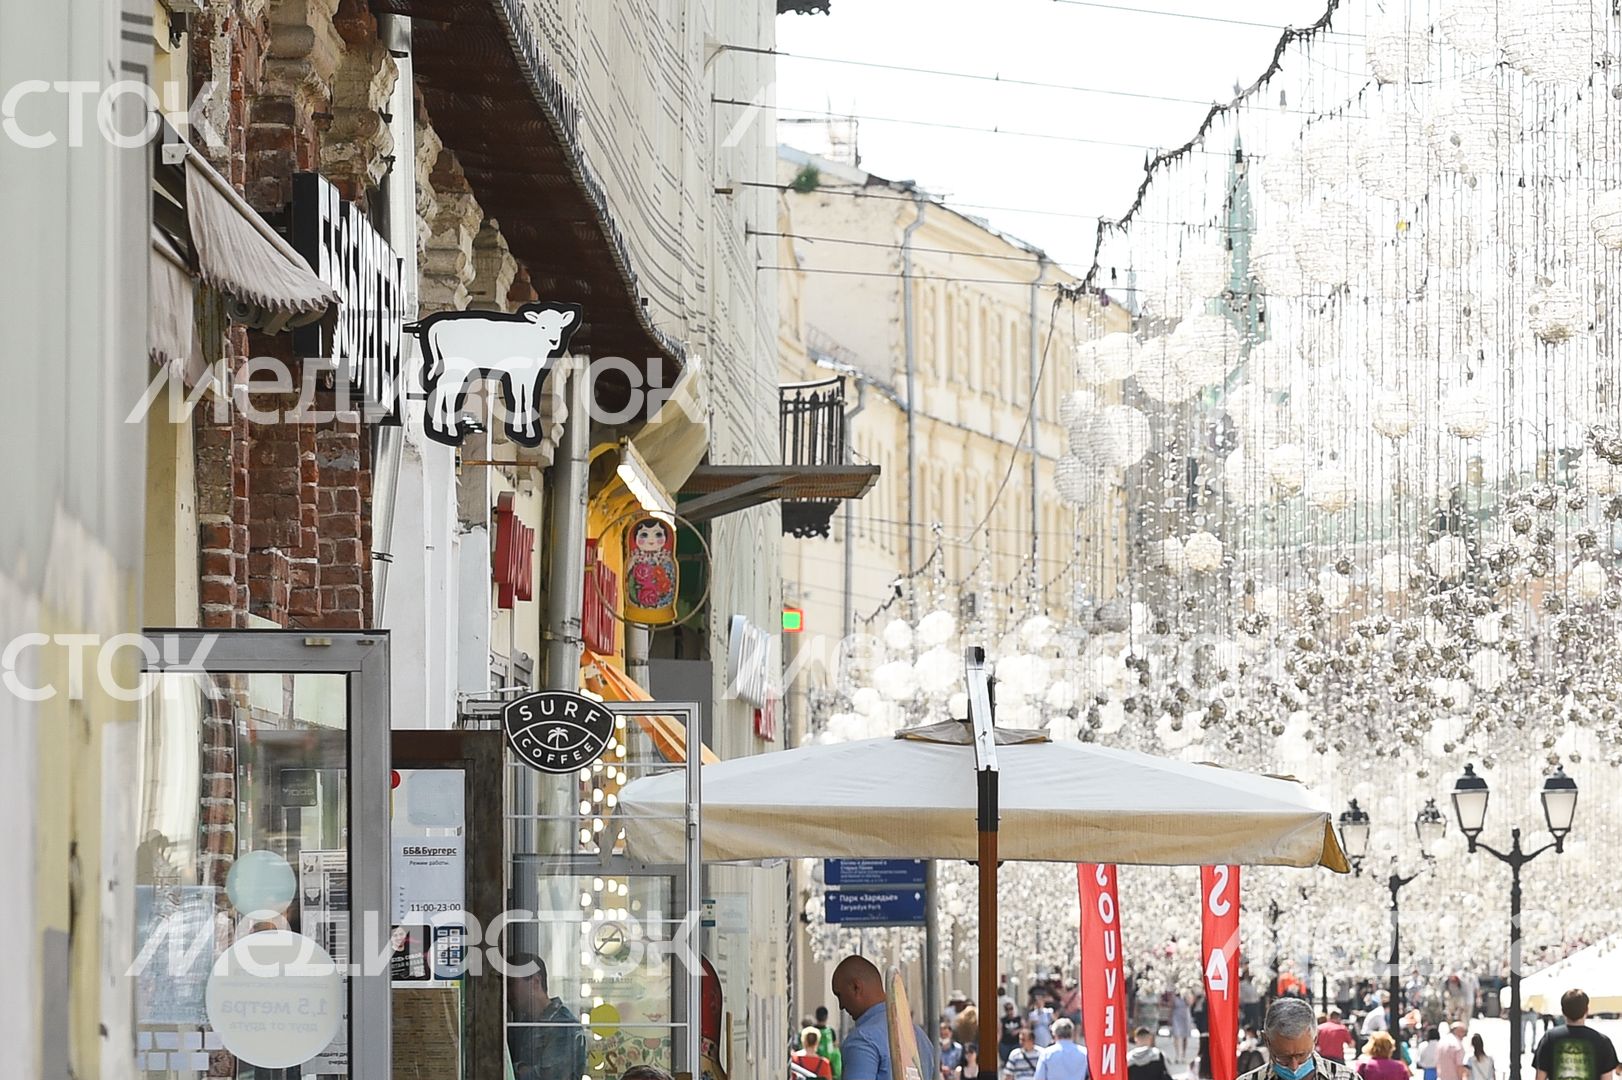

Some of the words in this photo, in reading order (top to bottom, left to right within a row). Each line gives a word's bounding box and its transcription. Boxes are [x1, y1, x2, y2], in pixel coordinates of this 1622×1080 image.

[519, 699, 601, 724] SURF
[521, 738, 594, 765] COFFEE
[402, 846, 457, 857] ББ&Бургерс
[839, 894, 858, 903] Парк
[410, 903, 461, 912] 11:00-23:00
